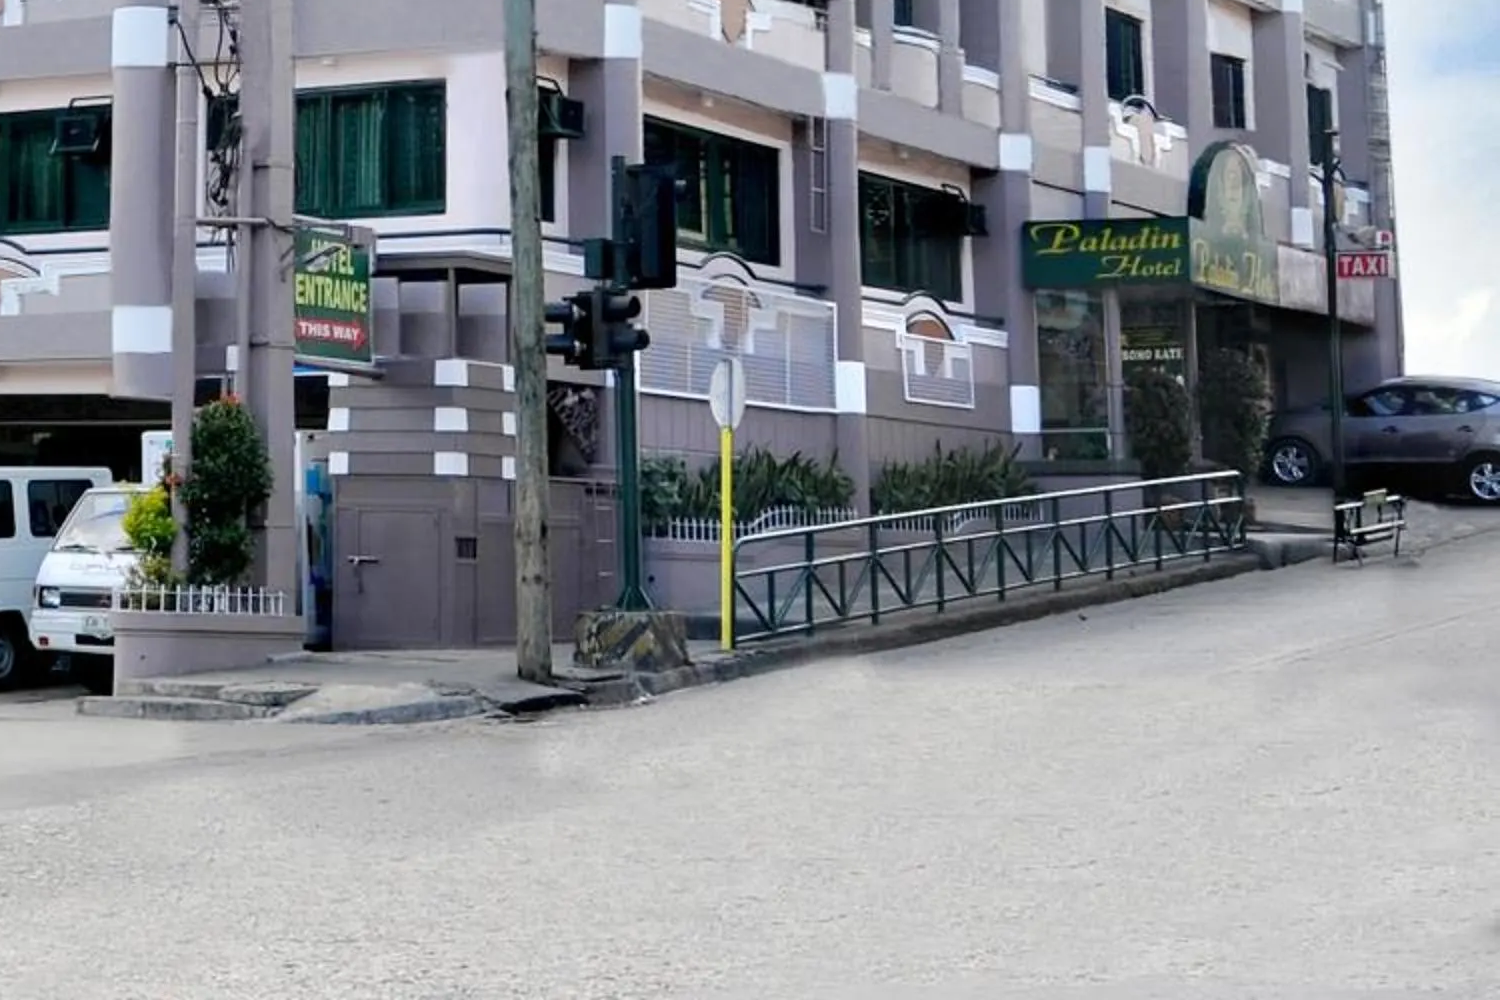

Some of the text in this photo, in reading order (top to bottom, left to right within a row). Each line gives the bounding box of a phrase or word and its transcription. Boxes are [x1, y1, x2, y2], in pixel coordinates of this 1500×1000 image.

[1030, 223, 1182, 255] Paladin
[309, 239, 355, 276] TEL
[1095, 255, 1182, 279] Hotel
[1340, 255, 1386, 276] TAXI
[295, 272, 367, 313] ENTRANCE
[298, 321, 361, 342] THIS WAY
